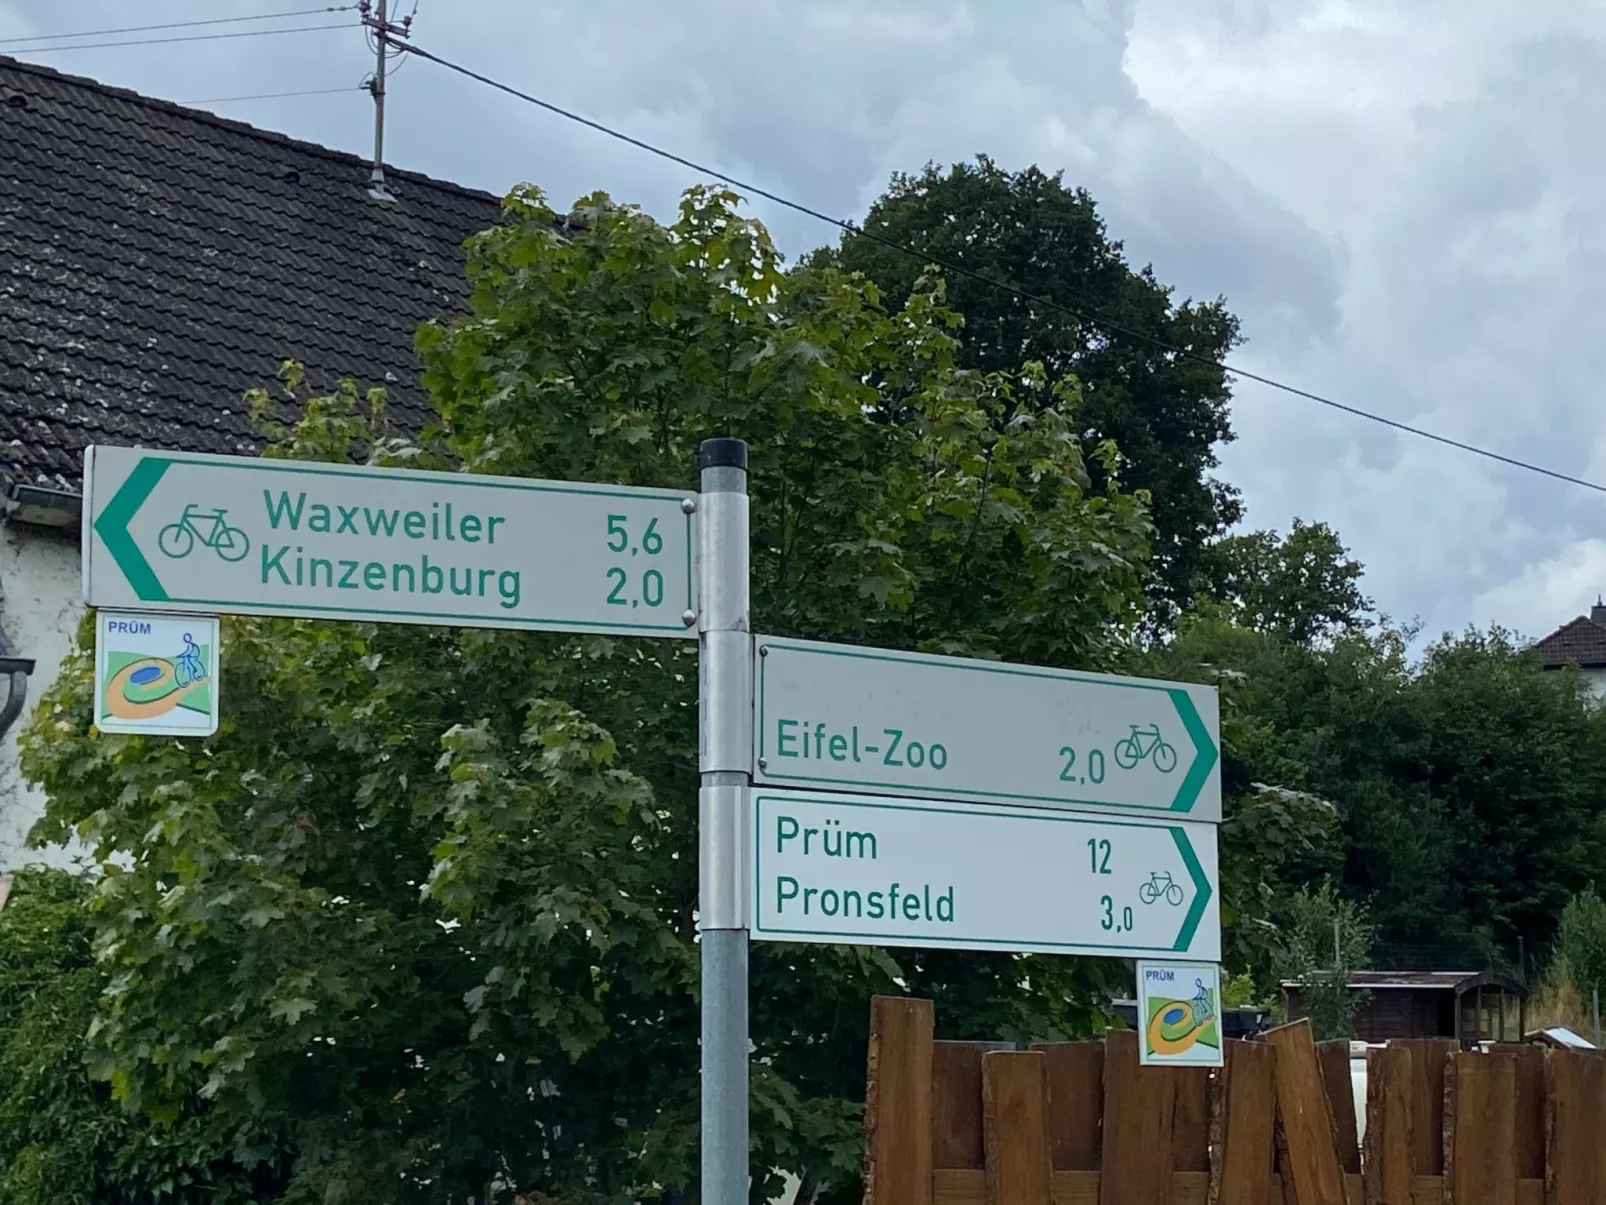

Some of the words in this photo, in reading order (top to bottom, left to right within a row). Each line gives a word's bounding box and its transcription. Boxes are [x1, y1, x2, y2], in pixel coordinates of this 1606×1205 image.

[262, 489, 507, 545] Waxweiler
[607, 515, 663, 557] 5,6
[260, 544, 521, 609] Kinzenburg
[606, 567, 664, 609] 2,0
[108, 620, 152, 635] PRÜM
[777, 719, 948, 771] Eifel-Zoo
[1059, 746, 1105, 785] 2,0
[777, 815, 877, 860] Prüm
[1087, 838, 1112, 875] 12
[777, 876, 954, 923] Pronsfeld
[1100, 895, 1133, 933] 3,0
[1145, 969, 1175, 982] PRÜM
